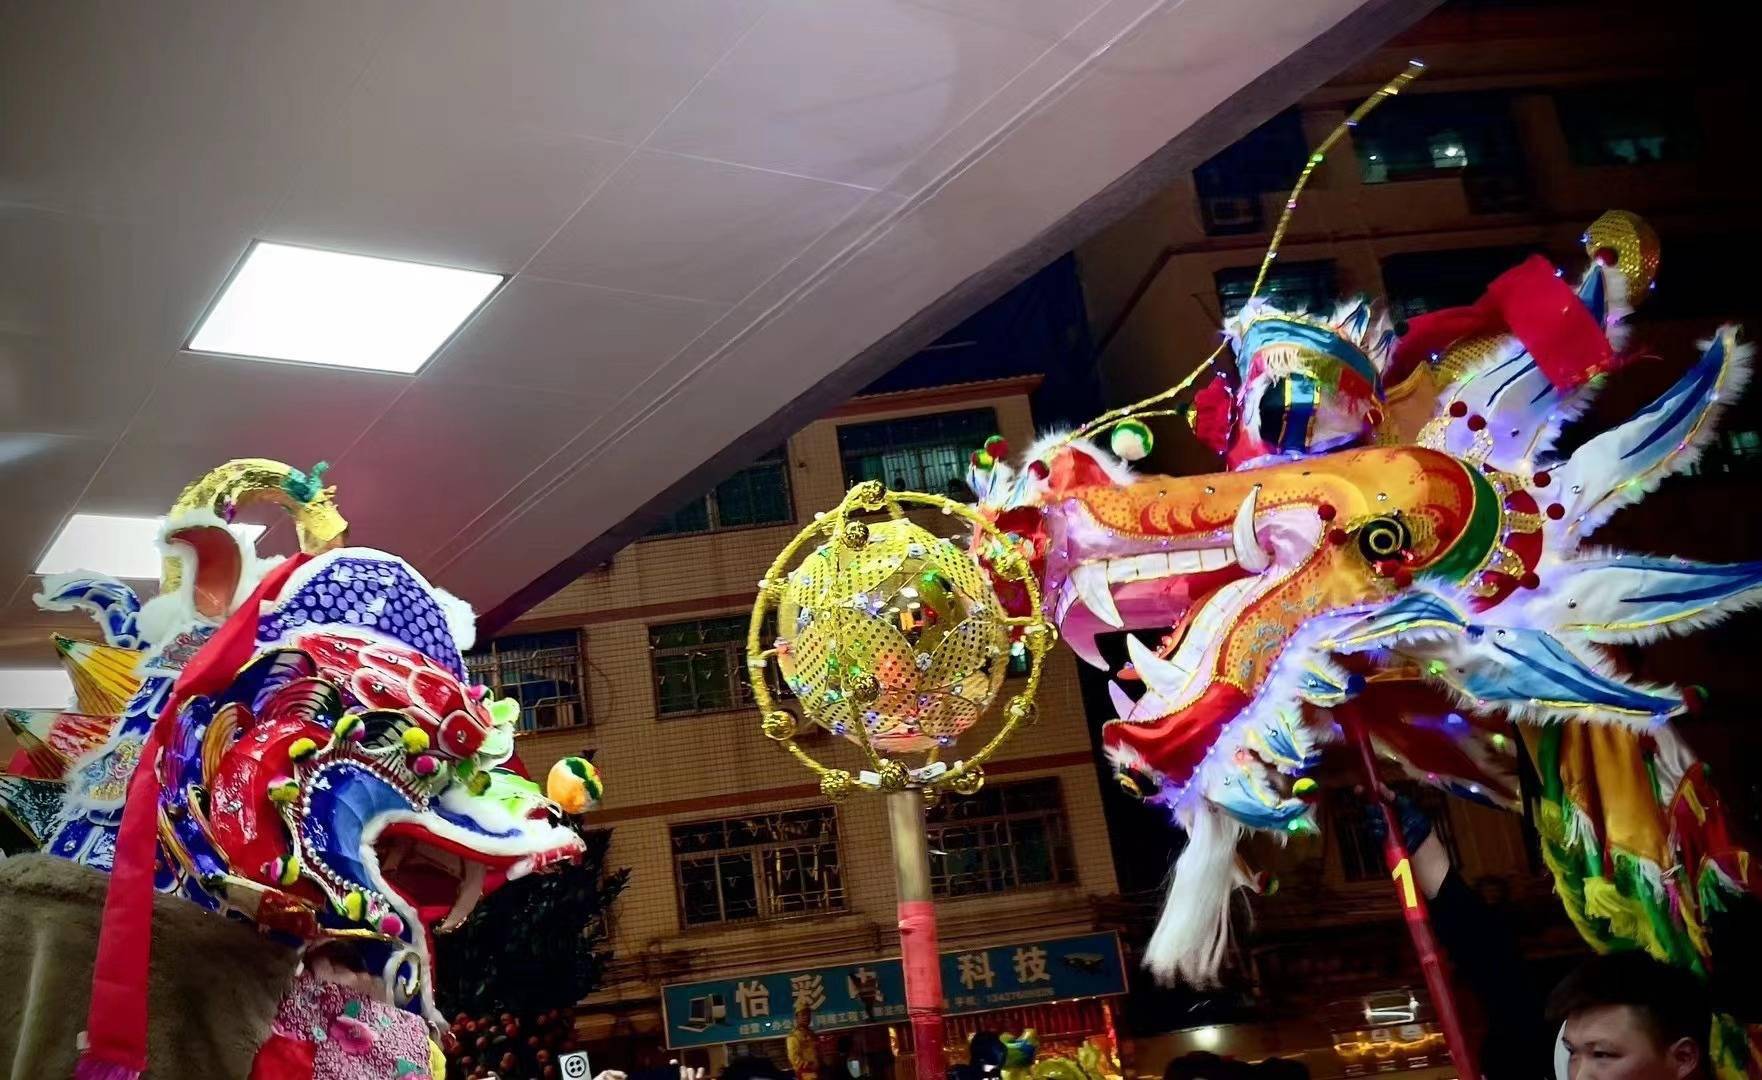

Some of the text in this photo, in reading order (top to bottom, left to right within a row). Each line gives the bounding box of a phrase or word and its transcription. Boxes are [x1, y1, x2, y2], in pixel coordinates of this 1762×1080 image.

[1391, 858, 1417, 908] 1
[735, 945, 1051, 1019] 怡彩电科技
